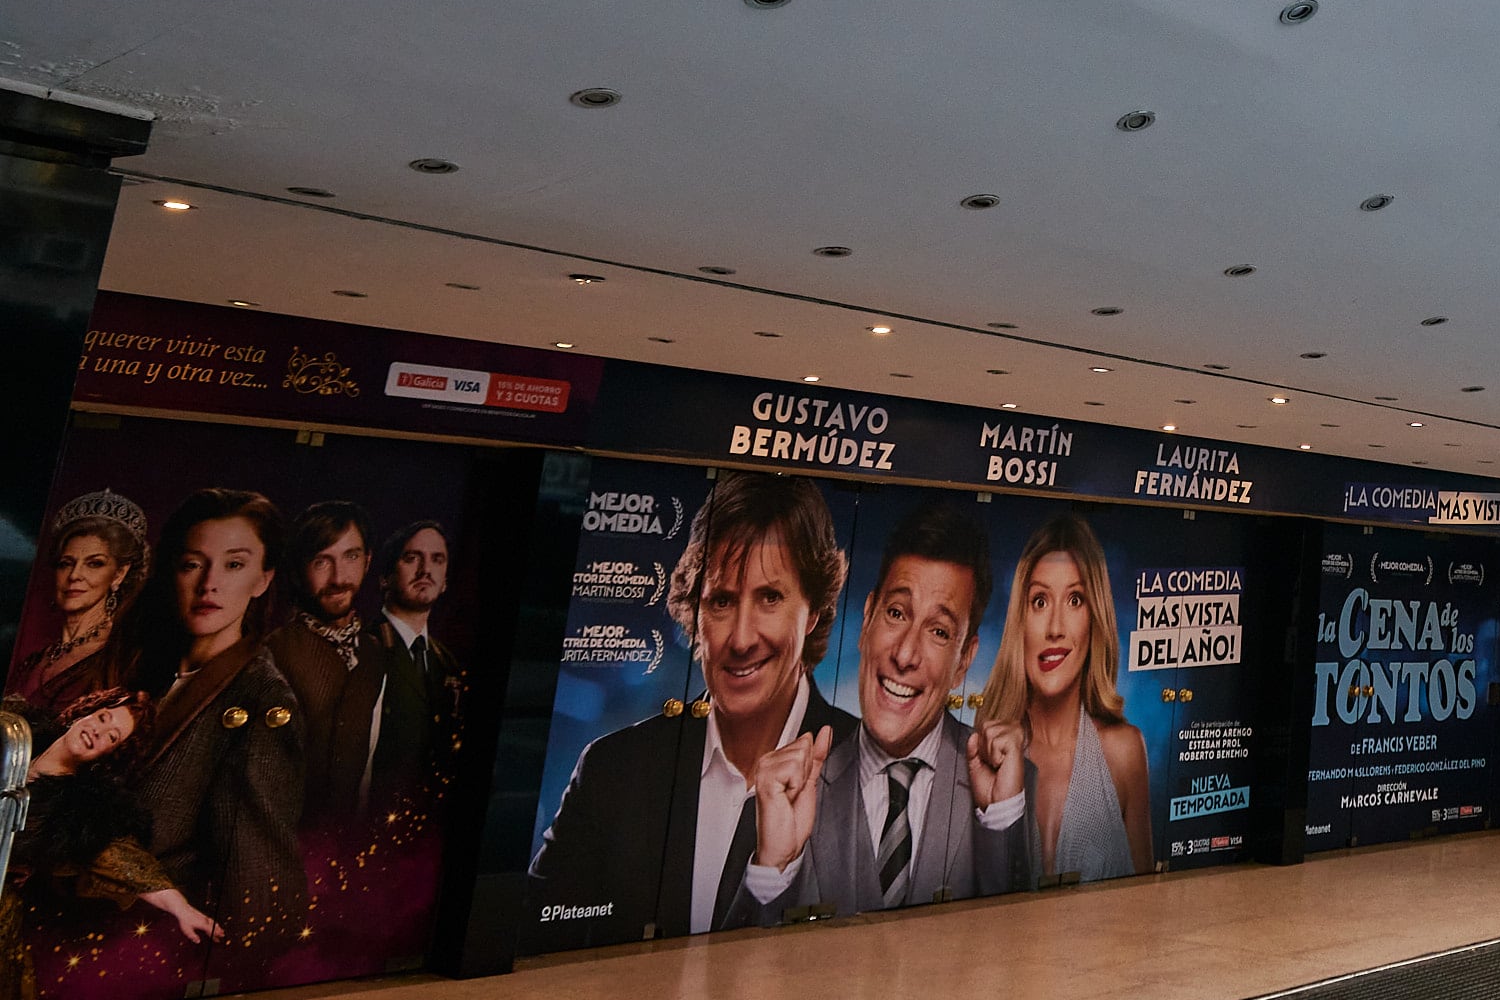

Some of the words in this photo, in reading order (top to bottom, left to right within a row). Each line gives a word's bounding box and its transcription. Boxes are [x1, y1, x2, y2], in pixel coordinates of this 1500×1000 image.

[84, 329, 162, 352] querer
[166, 335, 221, 359] vivir
[223, 344, 267, 364] esta
[94, 357, 139, 376] una
[144, 362, 164, 384] y
[166, 362, 212, 383] otra
[219, 369, 268, 389] vez...
[413, 377, 445, 389] Galicia
[454, 379, 480, 393] VISA
[514, 382, 526, 391] DE
[527, 383, 562, 395] AHORRO
[496, 391, 504, 400] Y
[505, 392, 513, 401] 3
[515, 392, 559, 407] CUOTAS
[752, 392, 889, 435] GUSTAVO
[729, 425, 896, 470] BERMÚDEZ
[979, 421, 1073, 456] MARTÍN
[1155, 443, 1240, 475] LAURITA
[986, 455, 1058, 487] BOSSI
[1134, 469, 1253, 504] FERNÁNDEZ
[588, 491, 654, 513] MEJOR
[1344, 485, 1369, 512] ¡LA
[1372, 486, 1437, 509] COMEDIA
[1438, 492, 1470, 521] MÁS
[582, 511, 663, 534] OMEDIA
[592, 561, 633, 574] MEJOR
[1380, 561, 1400, 570] MEJOR
[1400, 562, 1424, 573] COMEDIA
[573, 572, 599, 584] CTOR
[612, 574, 655, 586] COMEDIA
[1136, 572, 1164, 600] ¡LA
[1167, 570, 1242, 593] COMEDIA
[615, 586, 645, 598] BOSSI
[1139, 597, 1180, 629] MÁS
[1184, 602, 1235, 627] VISTA
[1317, 613, 1336, 643] la
[1338, 587, 1444, 659] CENA
[1441, 602, 1459, 627] de
[582, 625, 624, 637] MEJOR
[1451, 627, 1474, 653] los
[563, 637, 589, 648] CTRIZ
[604, 638, 647, 649] COMEDIA
[1138, 638, 1178, 667] DEL
[1181, 629, 1235, 664] AÑO!
[1312, 658, 1477, 726] TONTOS
[1179, 729, 1221, 740] GUILLERMO
[1222, 727, 1252, 738] ARENGO
[1188, 740, 1221, 751] ESTEBAN
[1222, 738, 1241, 748] PROL
[1179, 750, 1215, 761] ROBERTO
[1350, 743, 1361, 755] DE
[1362, 737, 1404, 754] FRANCIS
[1406, 735, 1438, 751] VEBER
[1308, 768, 1346, 782] FERNANDO
[1395, 762, 1425, 776] FEDERICO
[1426, 758, 1458, 772] GONZÁLEZ
[1459, 759, 1471, 769] DEL
[1471, 758, 1486, 768] PINO
[1191, 774, 1231, 795] NUEVA
[1377, 780, 1407, 792] DIRECCIÓN
[1173, 792, 1246, 817] TEMPORADA
[1341, 793, 1382, 809] MARCOS
[1384, 787, 1439, 804] CARNEVALE
[551, 901, 614, 920] Plateanet
